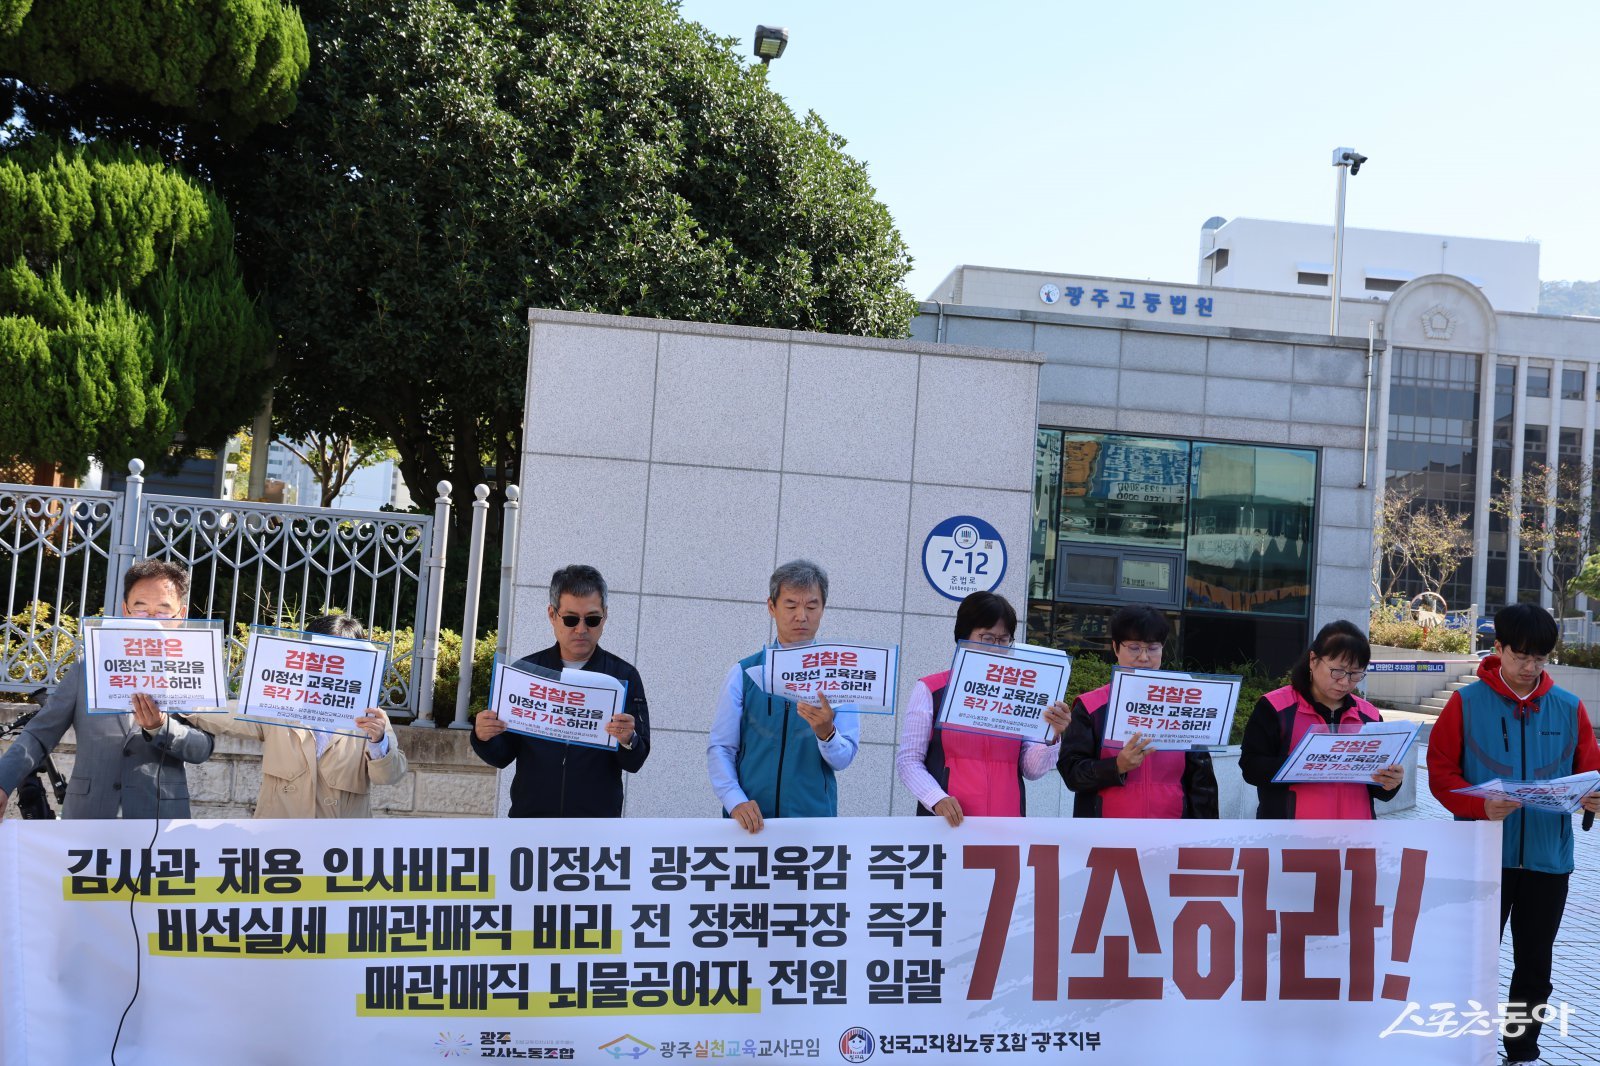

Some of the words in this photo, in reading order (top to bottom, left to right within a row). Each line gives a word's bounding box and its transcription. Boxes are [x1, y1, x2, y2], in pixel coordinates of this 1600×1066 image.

[1064, 285, 1214, 318] 광주고등법원
[941, 549, 989, 575] 7-12
[123, 637, 183, 657] 검찰은
[104, 659, 146, 673] 이정선
[150, 660, 205, 674] 교육감을
[285, 649, 345, 675] 검찰은
[801, 651, 858, 669] 검찰은
[109, 675, 138, 688] 즉각
[142, 675, 202, 689] 기소하라!
[261, 669, 303, 686] 이정선
[306, 675, 362, 694] 교육감을
[781, 668, 820, 681] 이정선
[824, 668, 877, 680] 교육감을
[784, 682, 811, 692] 즉각
[815, 680, 872, 692] 기소하라!
[985, 663, 1038, 688] 검찰은
[262, 685, 292, 701] 즉각
[295, 689, 356, 709] 기소하라!
[529, 682, 586, 706] 검찰은
[963, 680, 1001, 698] 이정선
[1002, 687, 1050, 706] 교육감을
[1147, 684, 1203, 704] 검찰은
[508, 693, 547, 712] 이정선
[551, 704, 604, 720] 교육감을
[510, 706, 537, 721] 즉각
[540, 711, 598, 730] 기소하라!
[963, 695, 988, 711] 즉각
[989, 700, 1042, 720] 기소하라!
[1125, 701, 1164, 716] 이정선
[1167, 705, 1218, 719] 교육감을
[1127, 715, 1153, 729] 즉각
[1156, 718, 1212, 731] 기소하라!
[1329, 740, 1382, 753] 검찰은
[66, 848, 200, 897] 감사관
[216, 848, 304, 895] 채용
[324, 846, 490, 894] 인사비리
[511, 845, 632, 892] 이정선
[650, 844, 851, 891] 광주교육감
[867, 844, 946, 890] 즉각
[157, 905, 328, 955] 비선실세
[348, 904, 512, 952] 매관매직
[532, 904, 613, 950] 비리
[630, 904, 671, 949] 전
[690, 902, 848, 949] 정책국장
[867, 901, 945, 948] 즉각
[962, 843, 1429, 1003] 기소하라!
[364, 963, 530, 1011] 매관매직
[549, 961, 752, 1009] 뇌물공여자
[767, 960, 848, 1006] 전원
[866, 959, 945, 1005] 일괄
[480, 1031, 511, 1045] 광주
[659, 1038, 820, 1059] 광주실천교육교사모임
[879, 1033, 1027, 1054] 전국교직원노동조합
[1031, 1031, 1101, 1053] 광주지부
[480, 1047, 575, 1060] 교사노동조합
